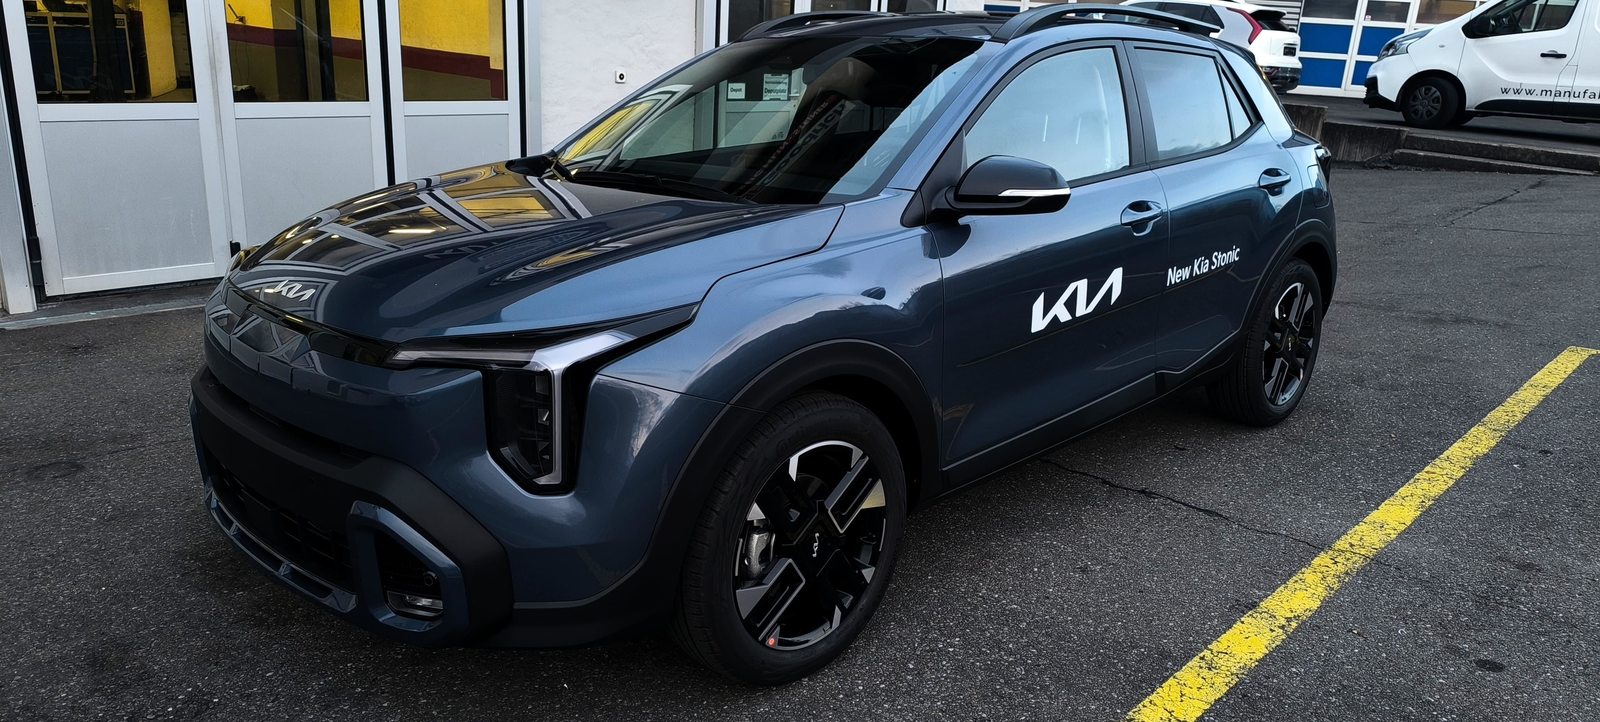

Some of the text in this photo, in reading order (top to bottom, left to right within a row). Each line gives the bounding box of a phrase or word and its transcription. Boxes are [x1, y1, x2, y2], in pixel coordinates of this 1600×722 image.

[1166, 245, 1240, 287] New Kia Stonic
[273, 279, 316, 302] KIA
[1031, 266, 1123, 333] KIA
